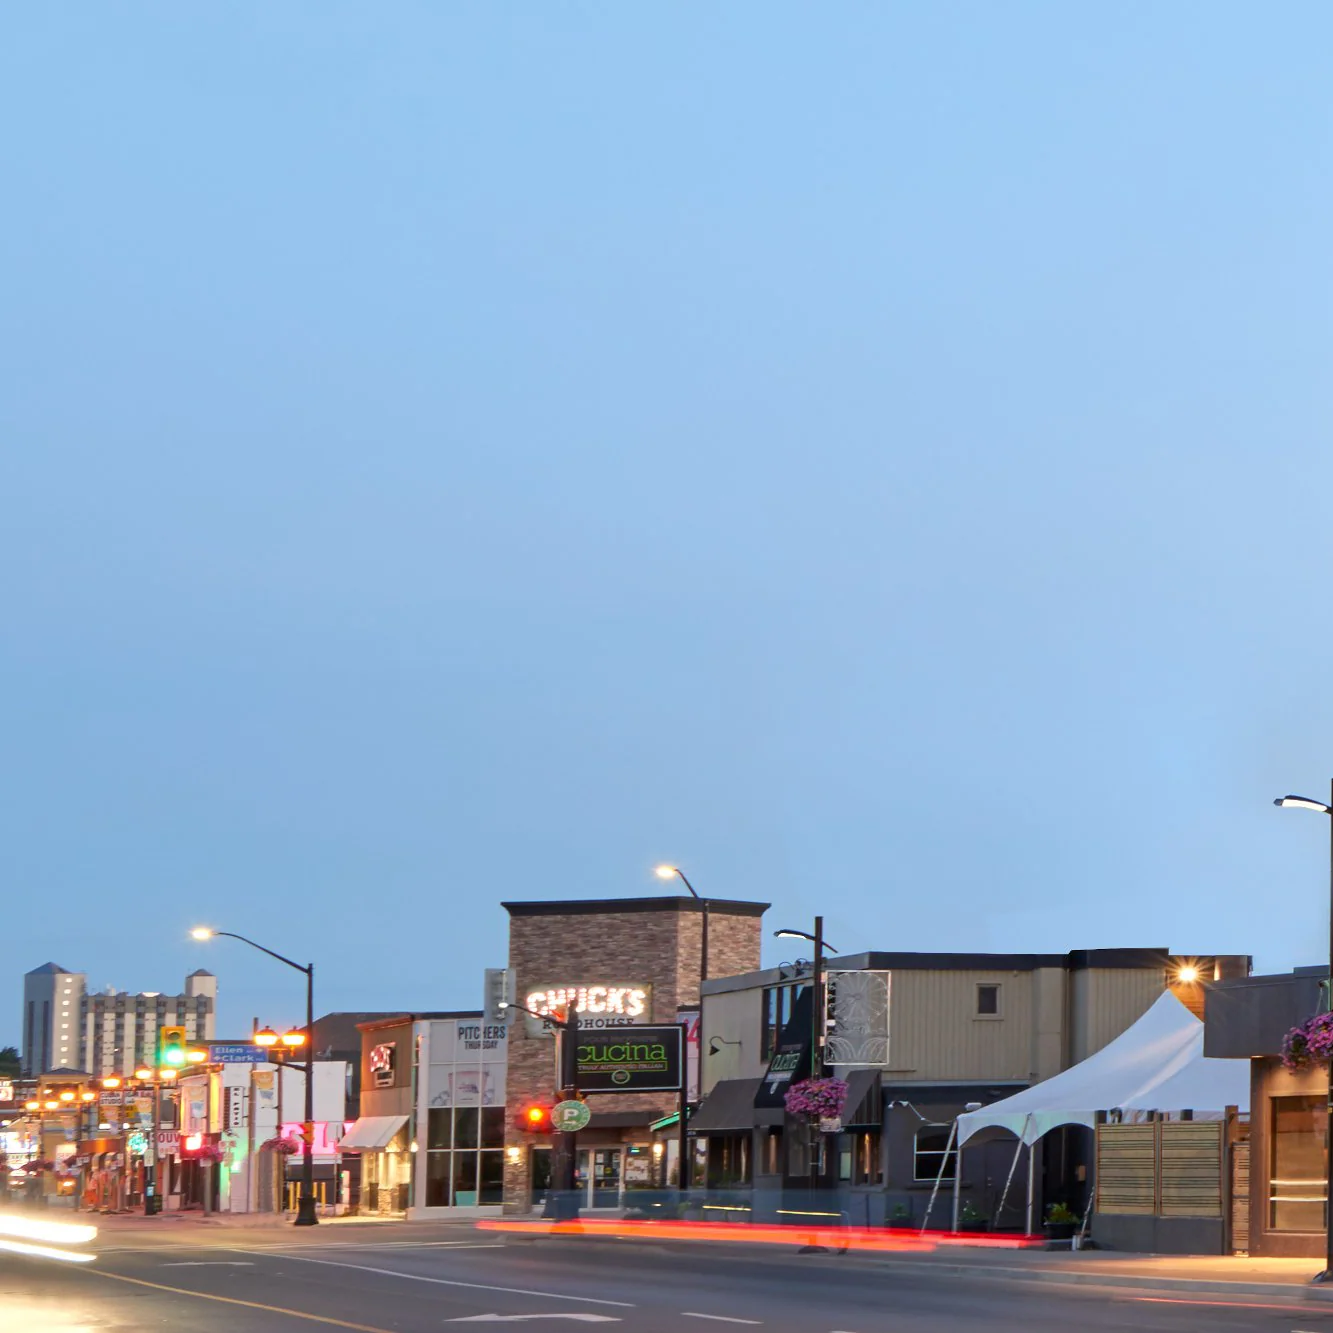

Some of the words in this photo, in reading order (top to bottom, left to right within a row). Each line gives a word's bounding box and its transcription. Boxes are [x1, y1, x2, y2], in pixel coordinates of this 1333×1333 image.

[458, 1026, 506, 1040] PITCHERS
[464, 1040, 499, 1050] THURSDAY
[577, 1042, 668, 1062] cucina
[563, 1108, 579, 1120] P
